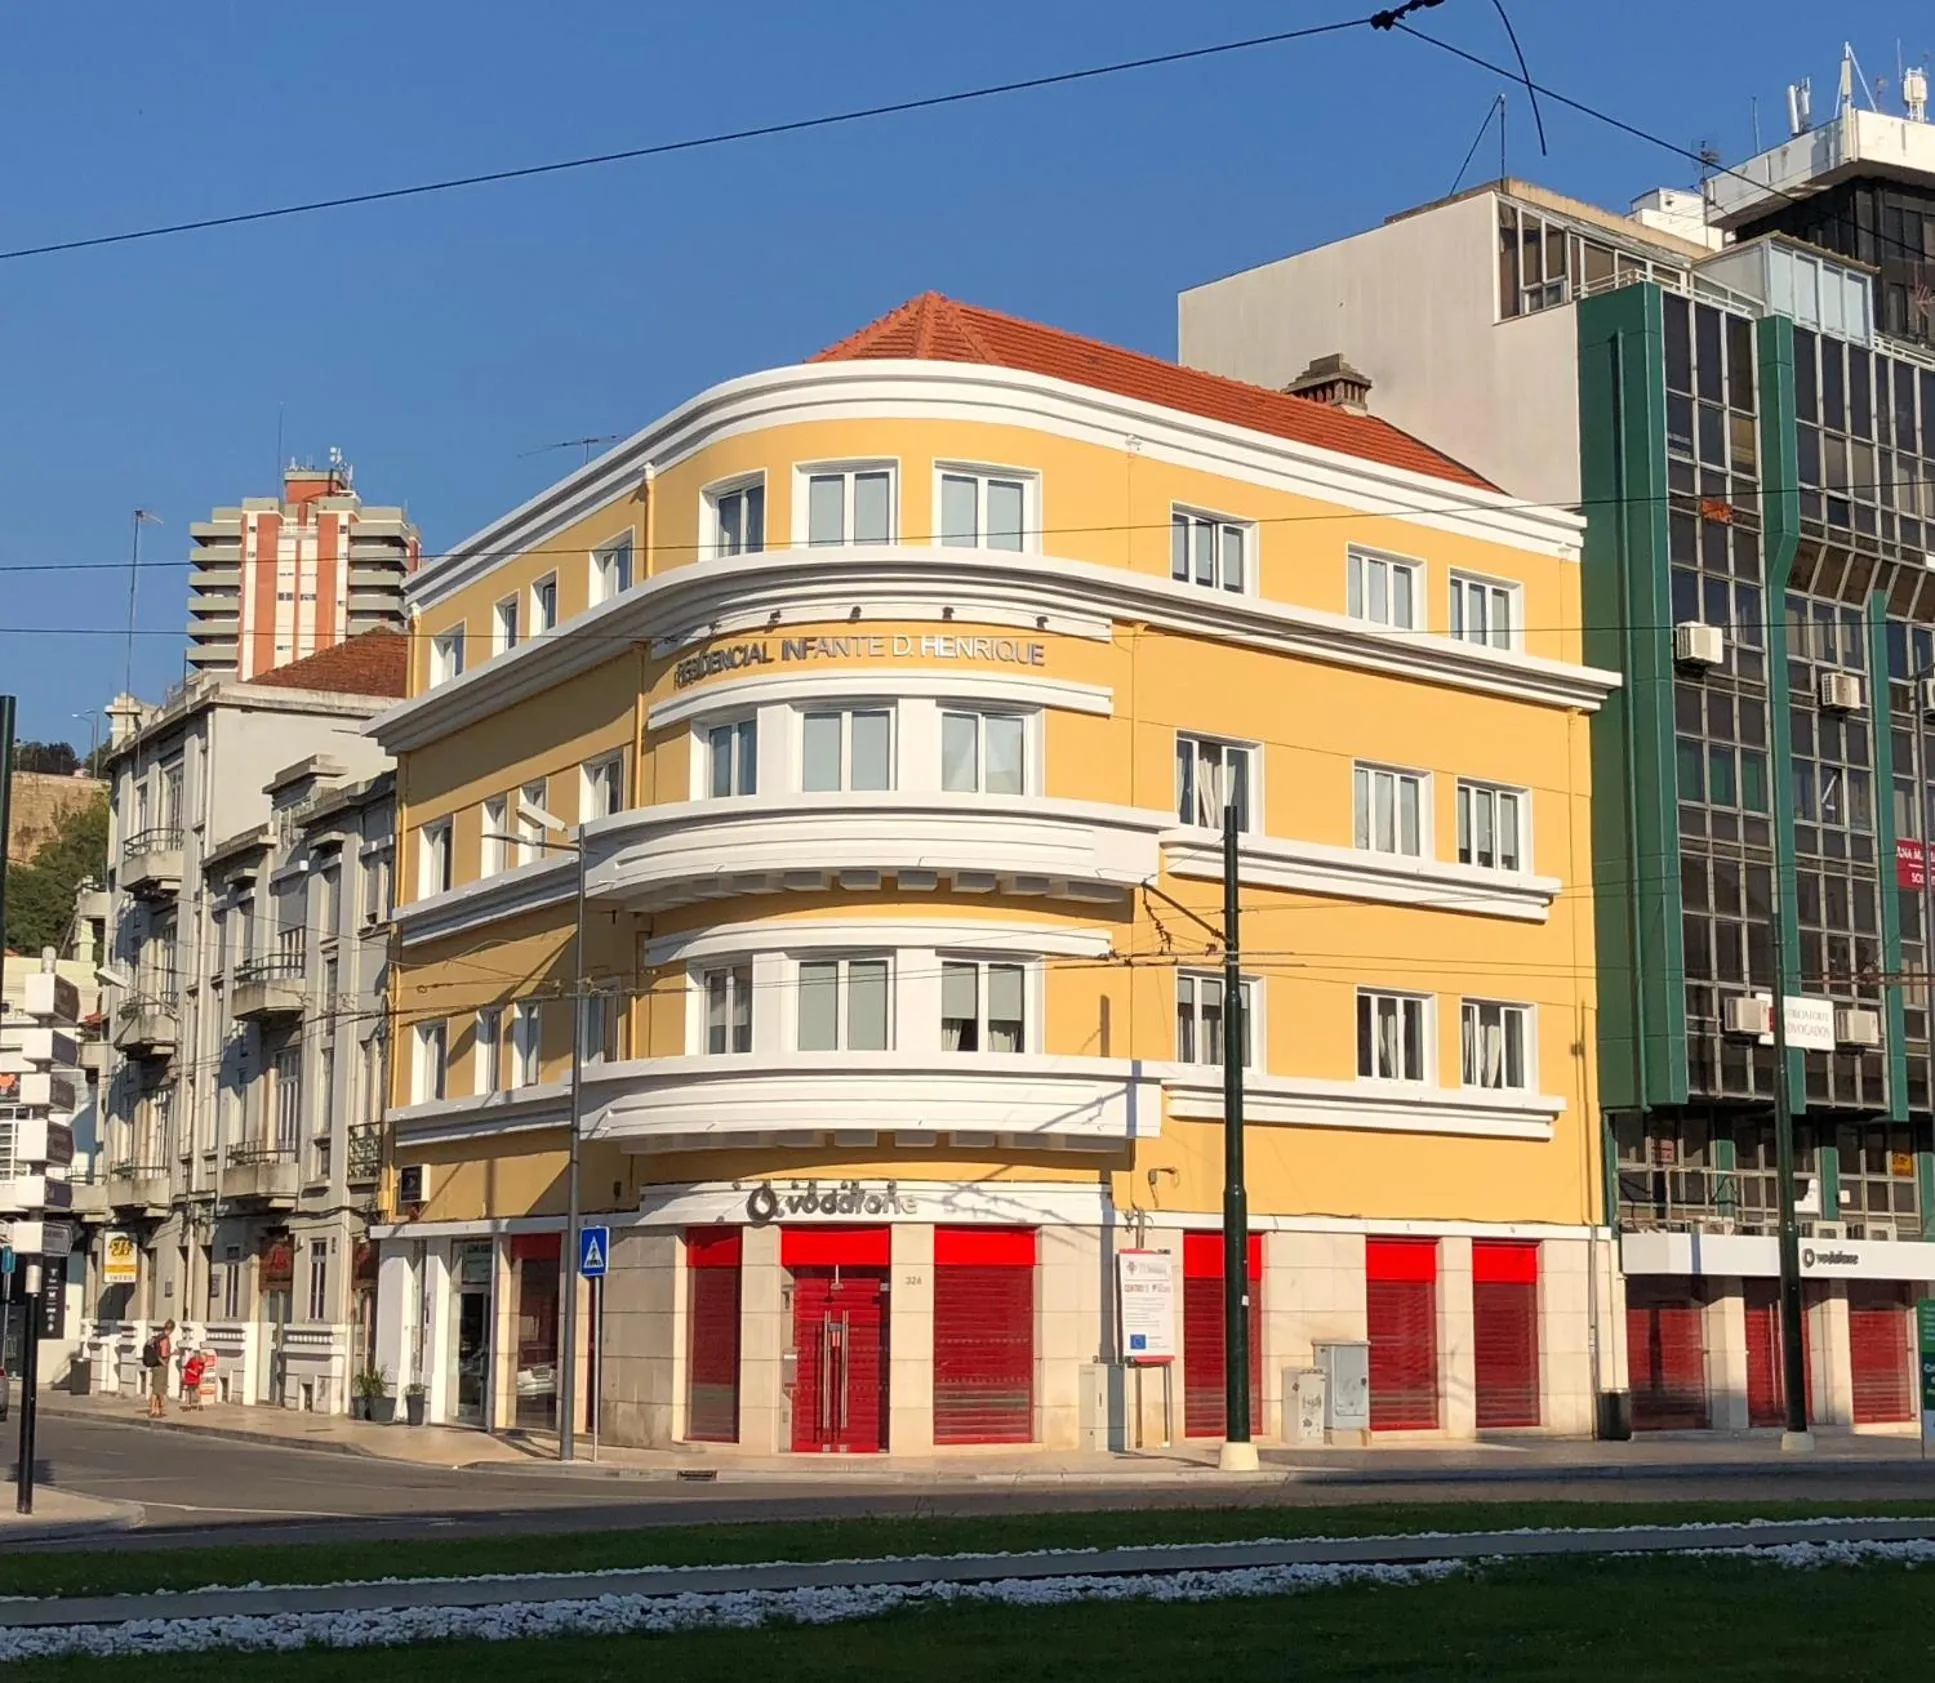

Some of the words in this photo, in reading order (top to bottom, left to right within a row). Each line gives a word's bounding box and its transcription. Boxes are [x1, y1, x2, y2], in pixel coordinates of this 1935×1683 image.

[673, 641, 774, 690] RESIDENCIAL
[782, 636, 886, 662] INFANTE
[892, 635, 914, 657] D.
[920, 635, 1046, 666] HENRIQUE
[786, 1188, 918, 1215] vodafone
[1815, 1250, 1859, 1265] vodafone
